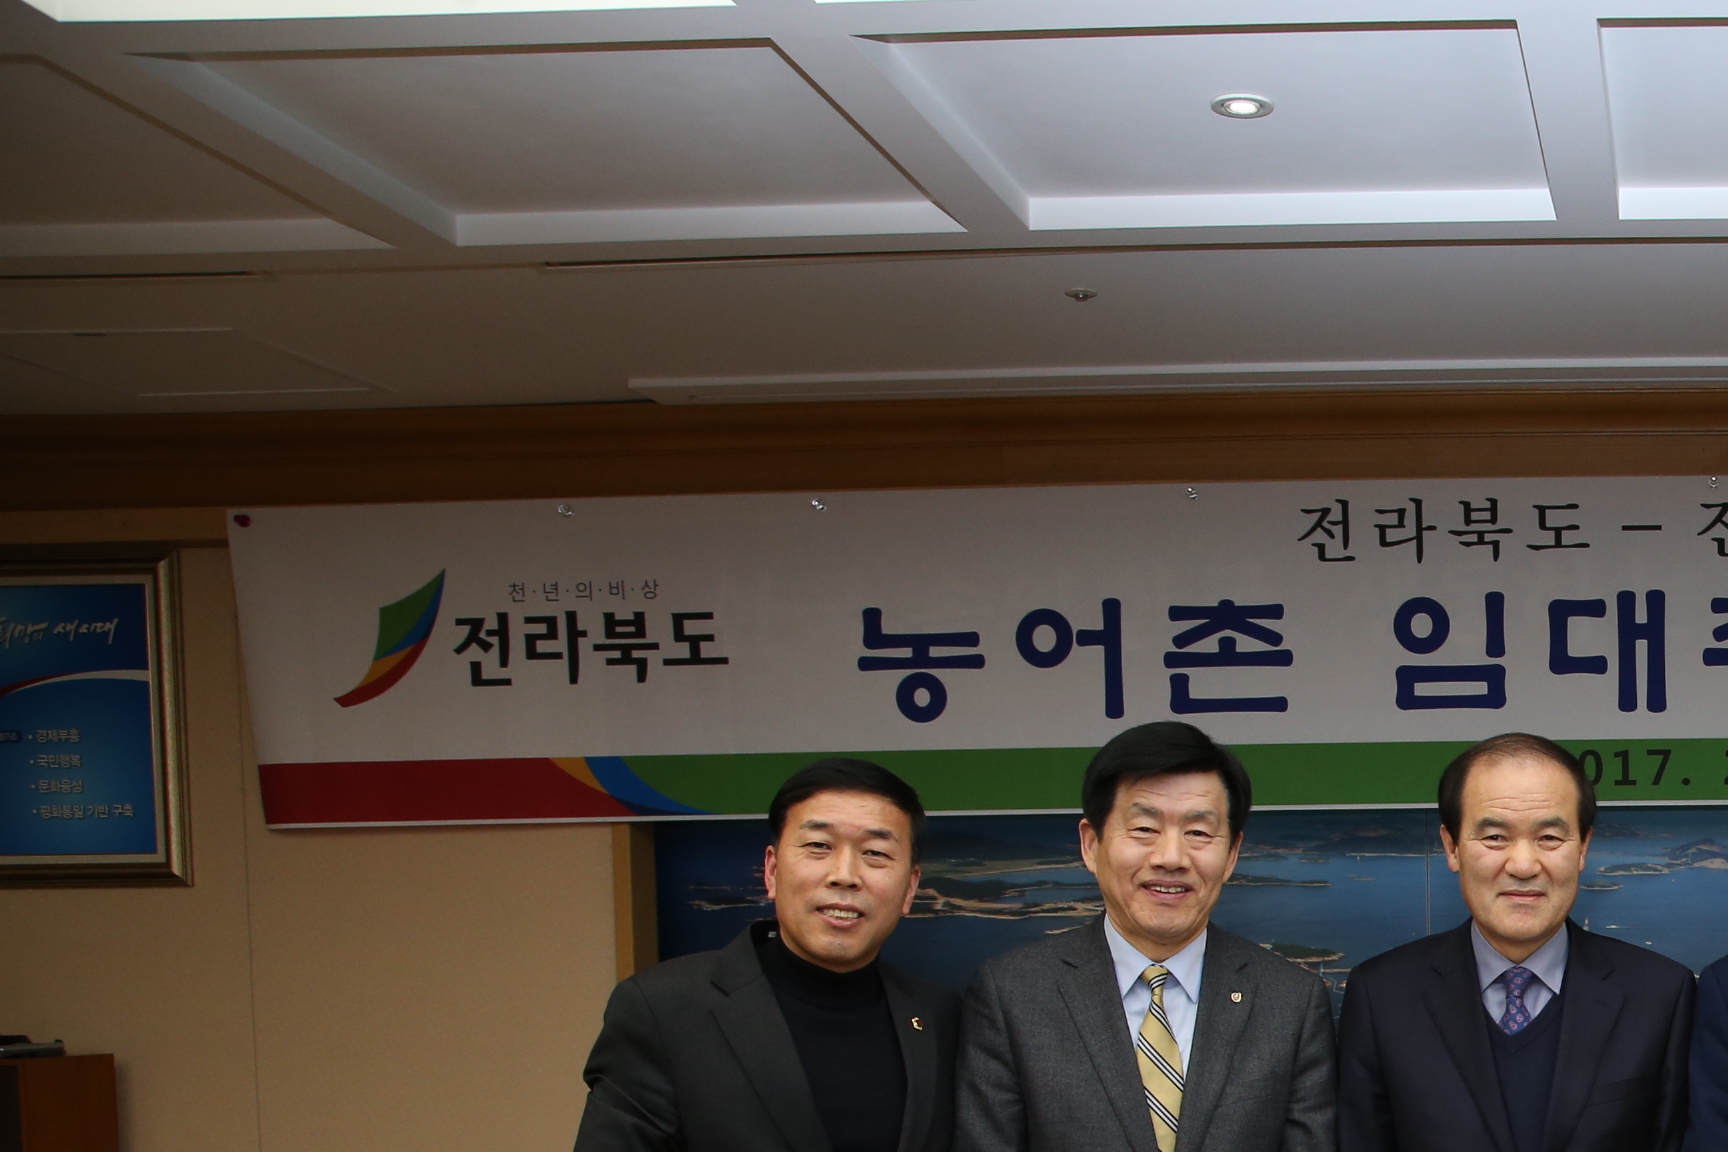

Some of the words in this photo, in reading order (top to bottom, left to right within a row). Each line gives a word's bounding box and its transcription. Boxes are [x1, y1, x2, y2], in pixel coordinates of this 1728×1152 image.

[1298, 498, 1590, 564] 전라북도
[452, 607, 730, 687] 전라북도
[858, 598, 1293, 723] 농어촌
[87, 804, 109, 818] 기반
